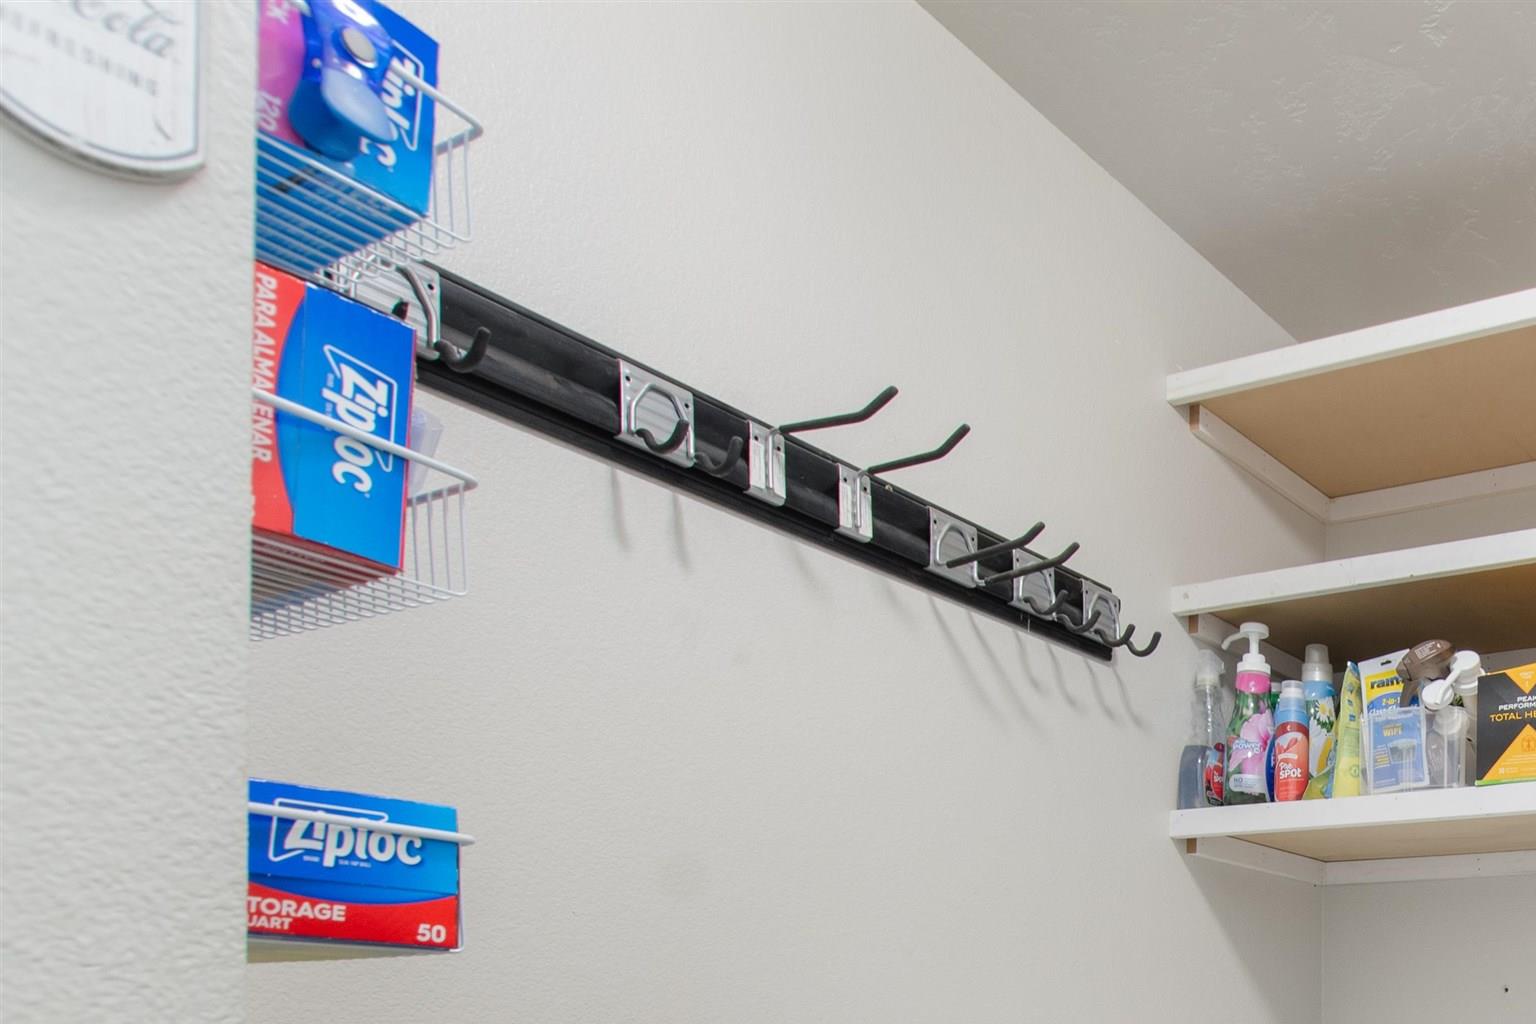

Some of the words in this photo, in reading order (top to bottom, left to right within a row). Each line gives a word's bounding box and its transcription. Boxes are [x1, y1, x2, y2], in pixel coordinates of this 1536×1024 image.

[254, 272, 278, 329] PARA
[252, 330, 275, 462] ALMAENAR
[322, 363, 389, 493] Zipoc
[1489, 710, 1522, 723] TOTAL
[283, 810, 422, 868] Ziploc
[248, 896, 346, 922] TORAGE
[248, 914, 294, 930] UART
[416, 923, 447, 943] 50
